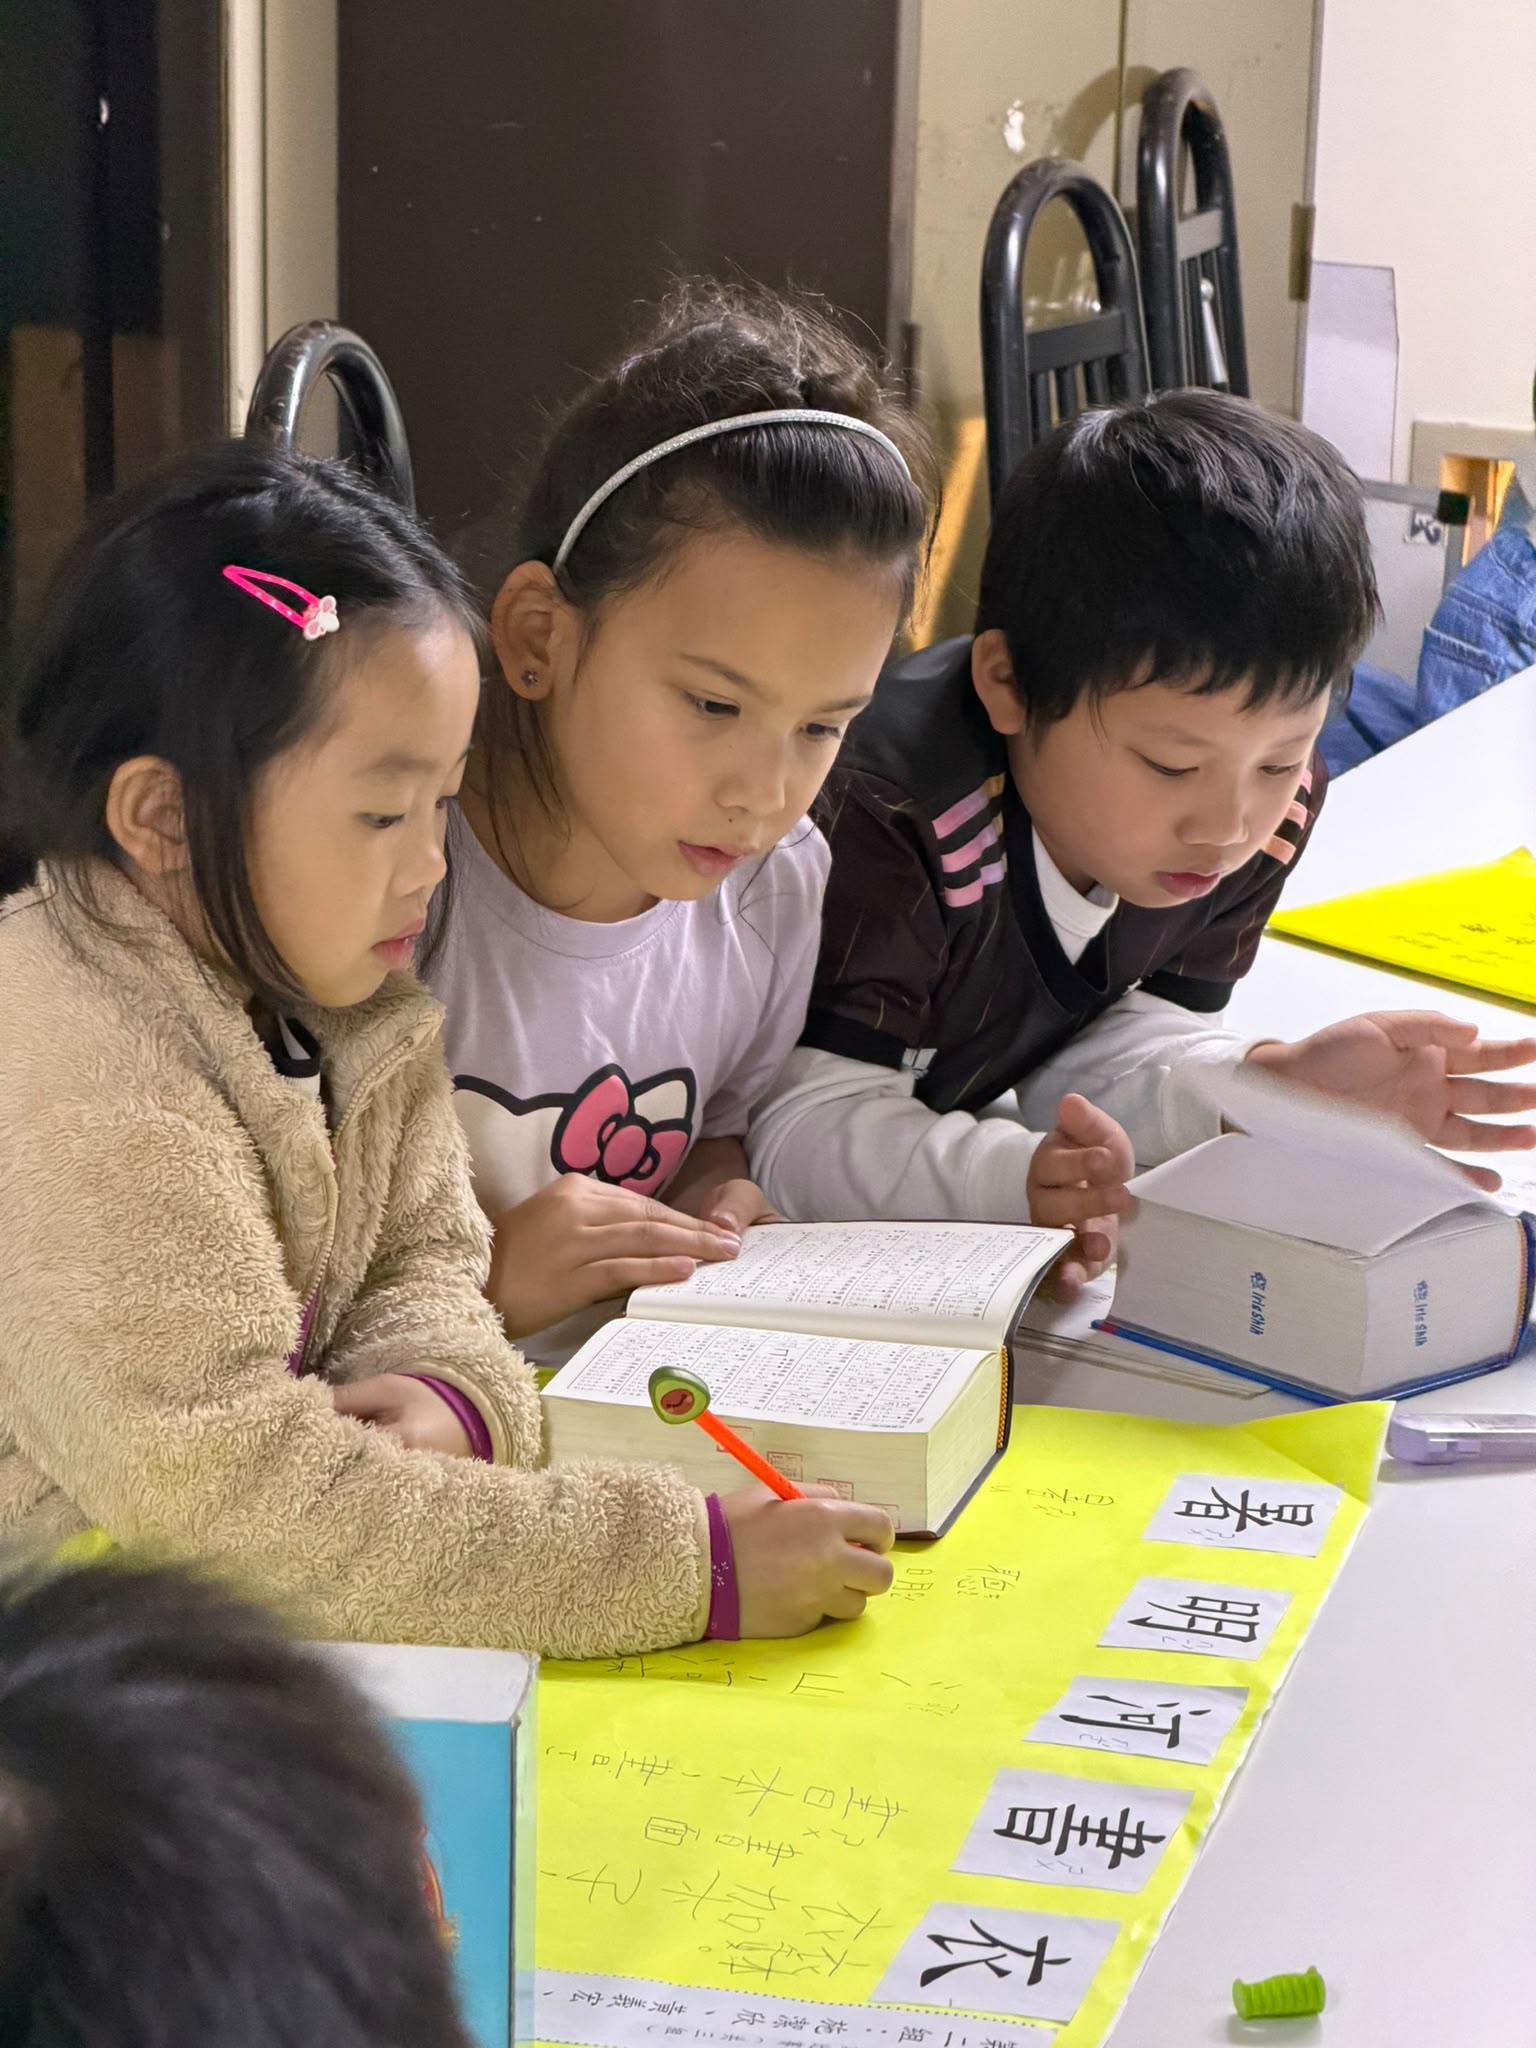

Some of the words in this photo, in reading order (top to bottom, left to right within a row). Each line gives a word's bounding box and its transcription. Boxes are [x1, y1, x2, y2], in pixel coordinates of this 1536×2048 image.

[1174, 1486, 1315, 1533] 暑
[1127, 1595, 1261, 1644] 明
[1058, 1694, 1213, 1750] 河
[993, 1803, 1167, 1870] 書
[919, 1917, 1073, 1989] 衣
